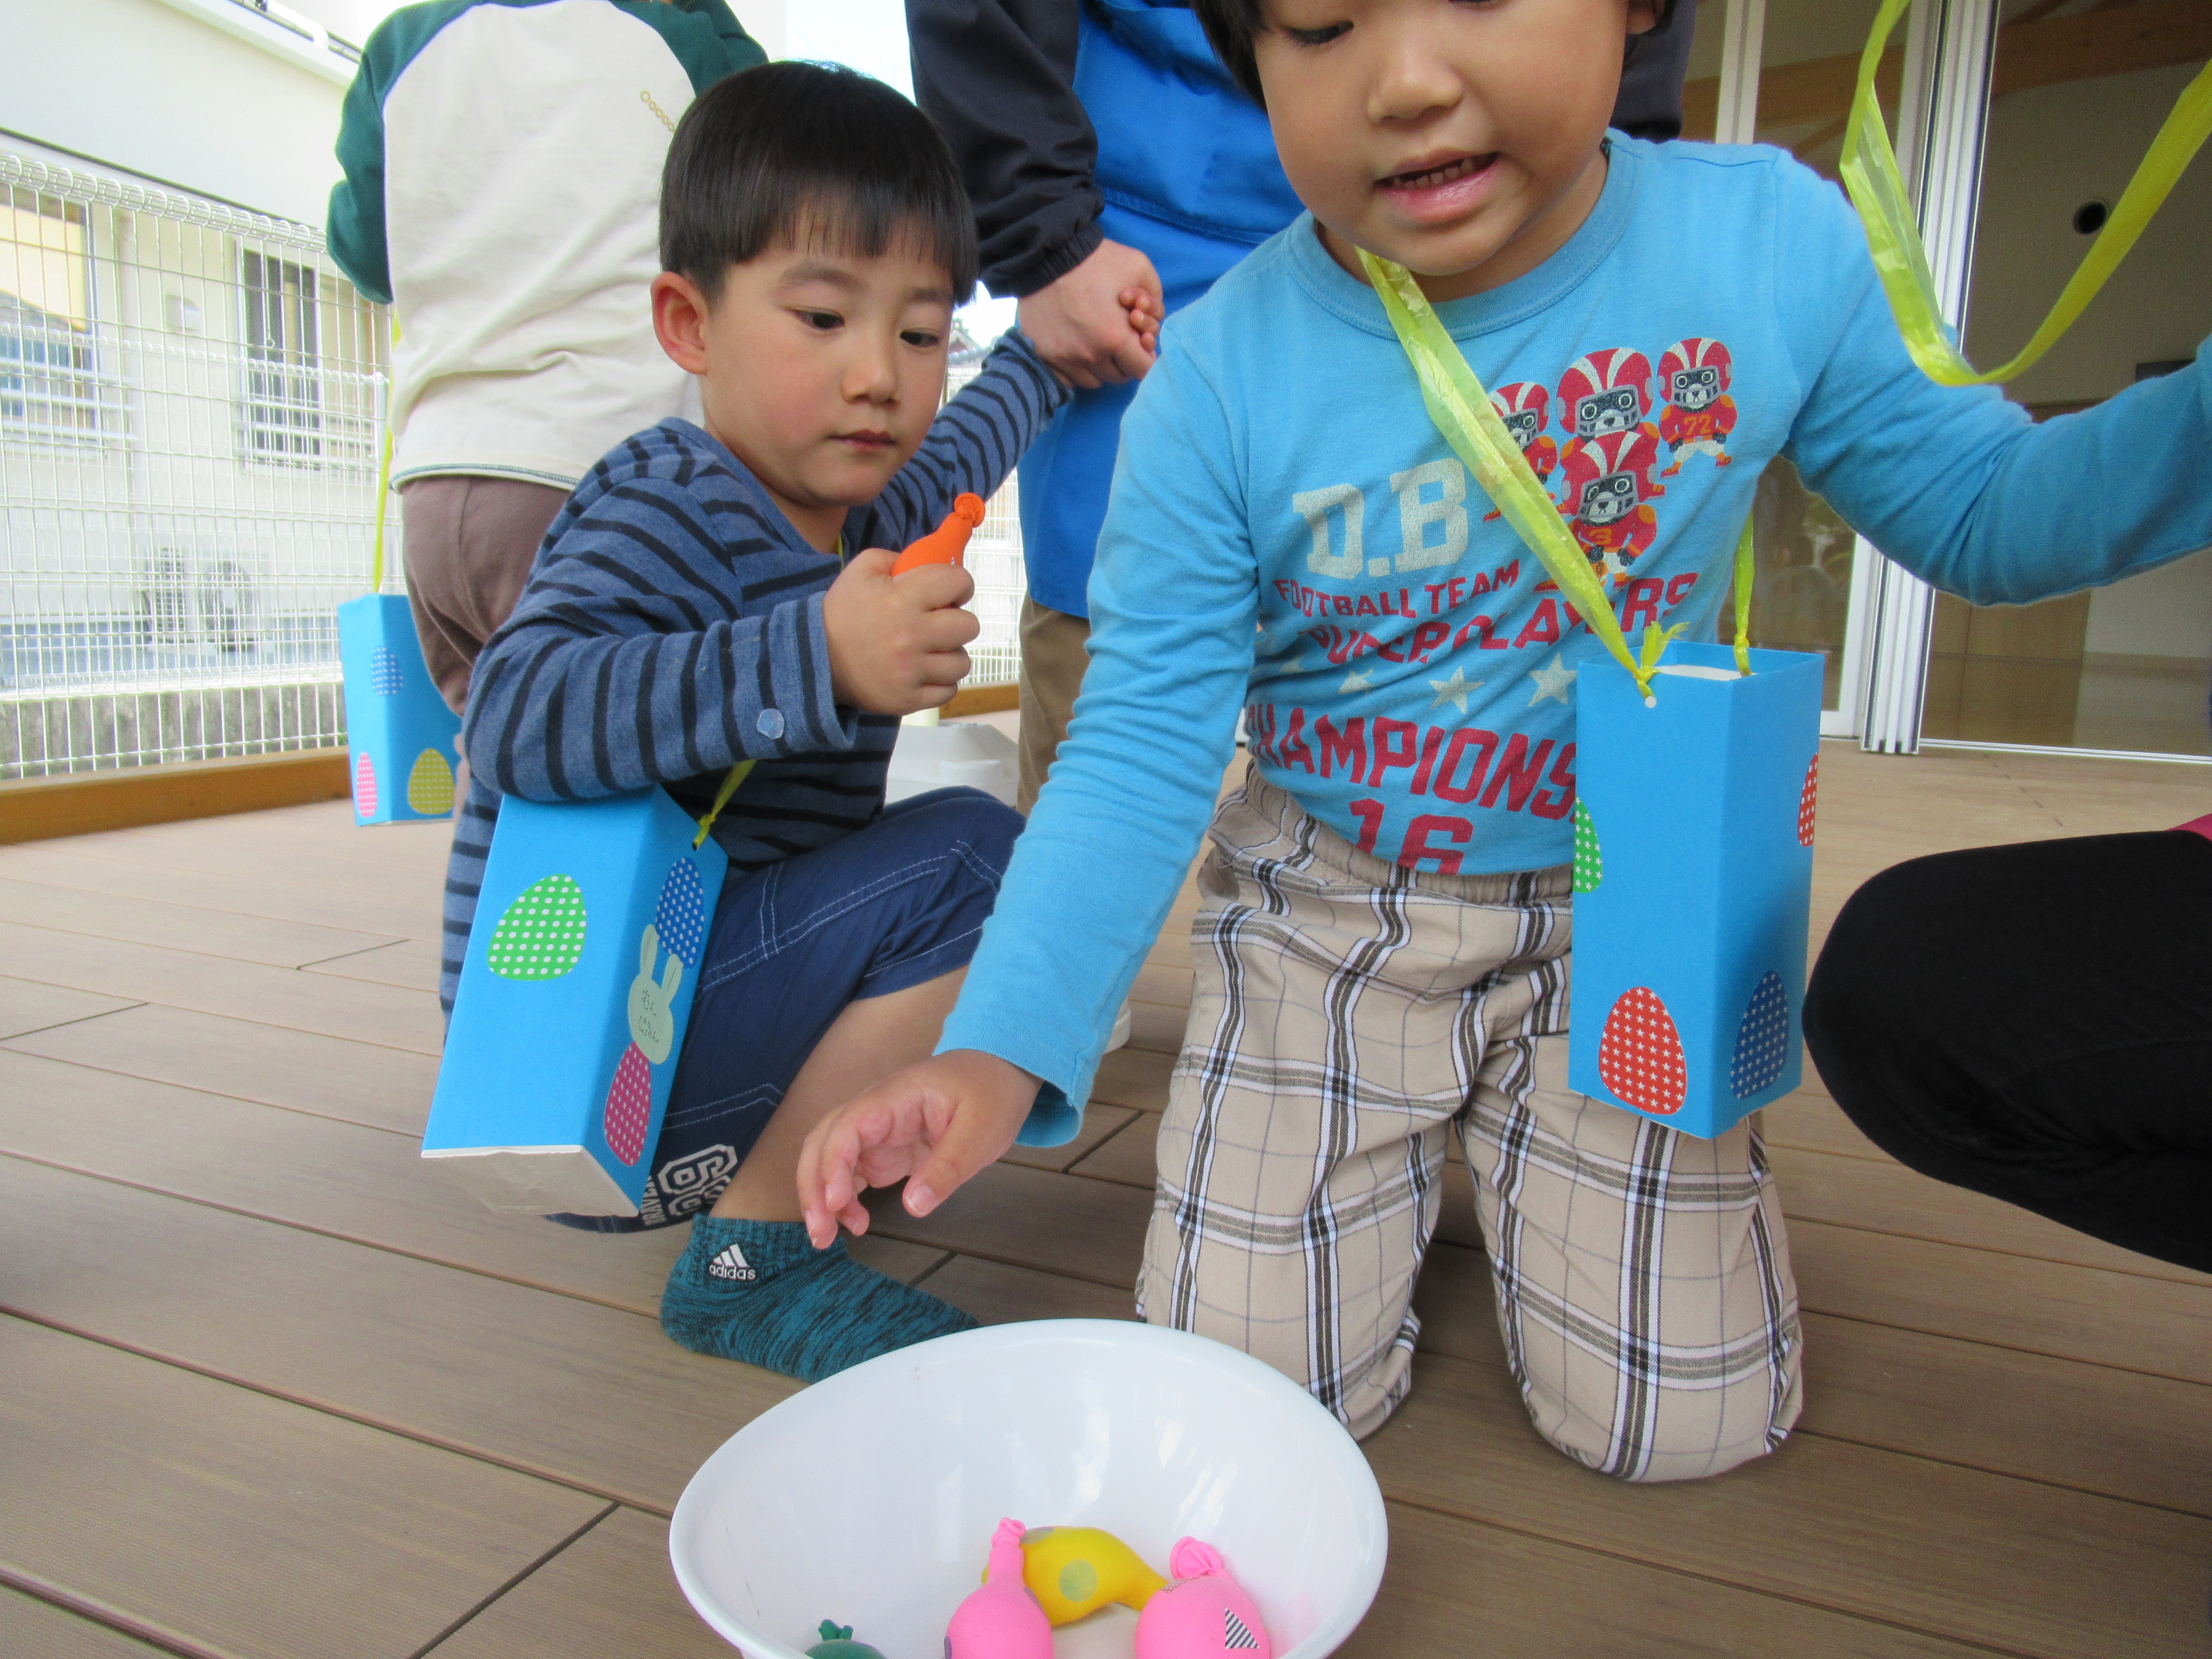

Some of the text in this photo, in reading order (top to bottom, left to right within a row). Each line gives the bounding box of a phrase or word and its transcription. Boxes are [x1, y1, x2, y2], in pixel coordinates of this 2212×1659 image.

[1683, 415, 1711, 435] 72
[1589, 528, 1612, 545] 3
[1273, 559, 1519, 618] FOOTBALL TEAM
[1245, 703, 1576, 824] CHAMPIONS
[1349, 798, 1474, 875] 16
[709, 1264, 756, 1280] adidas
